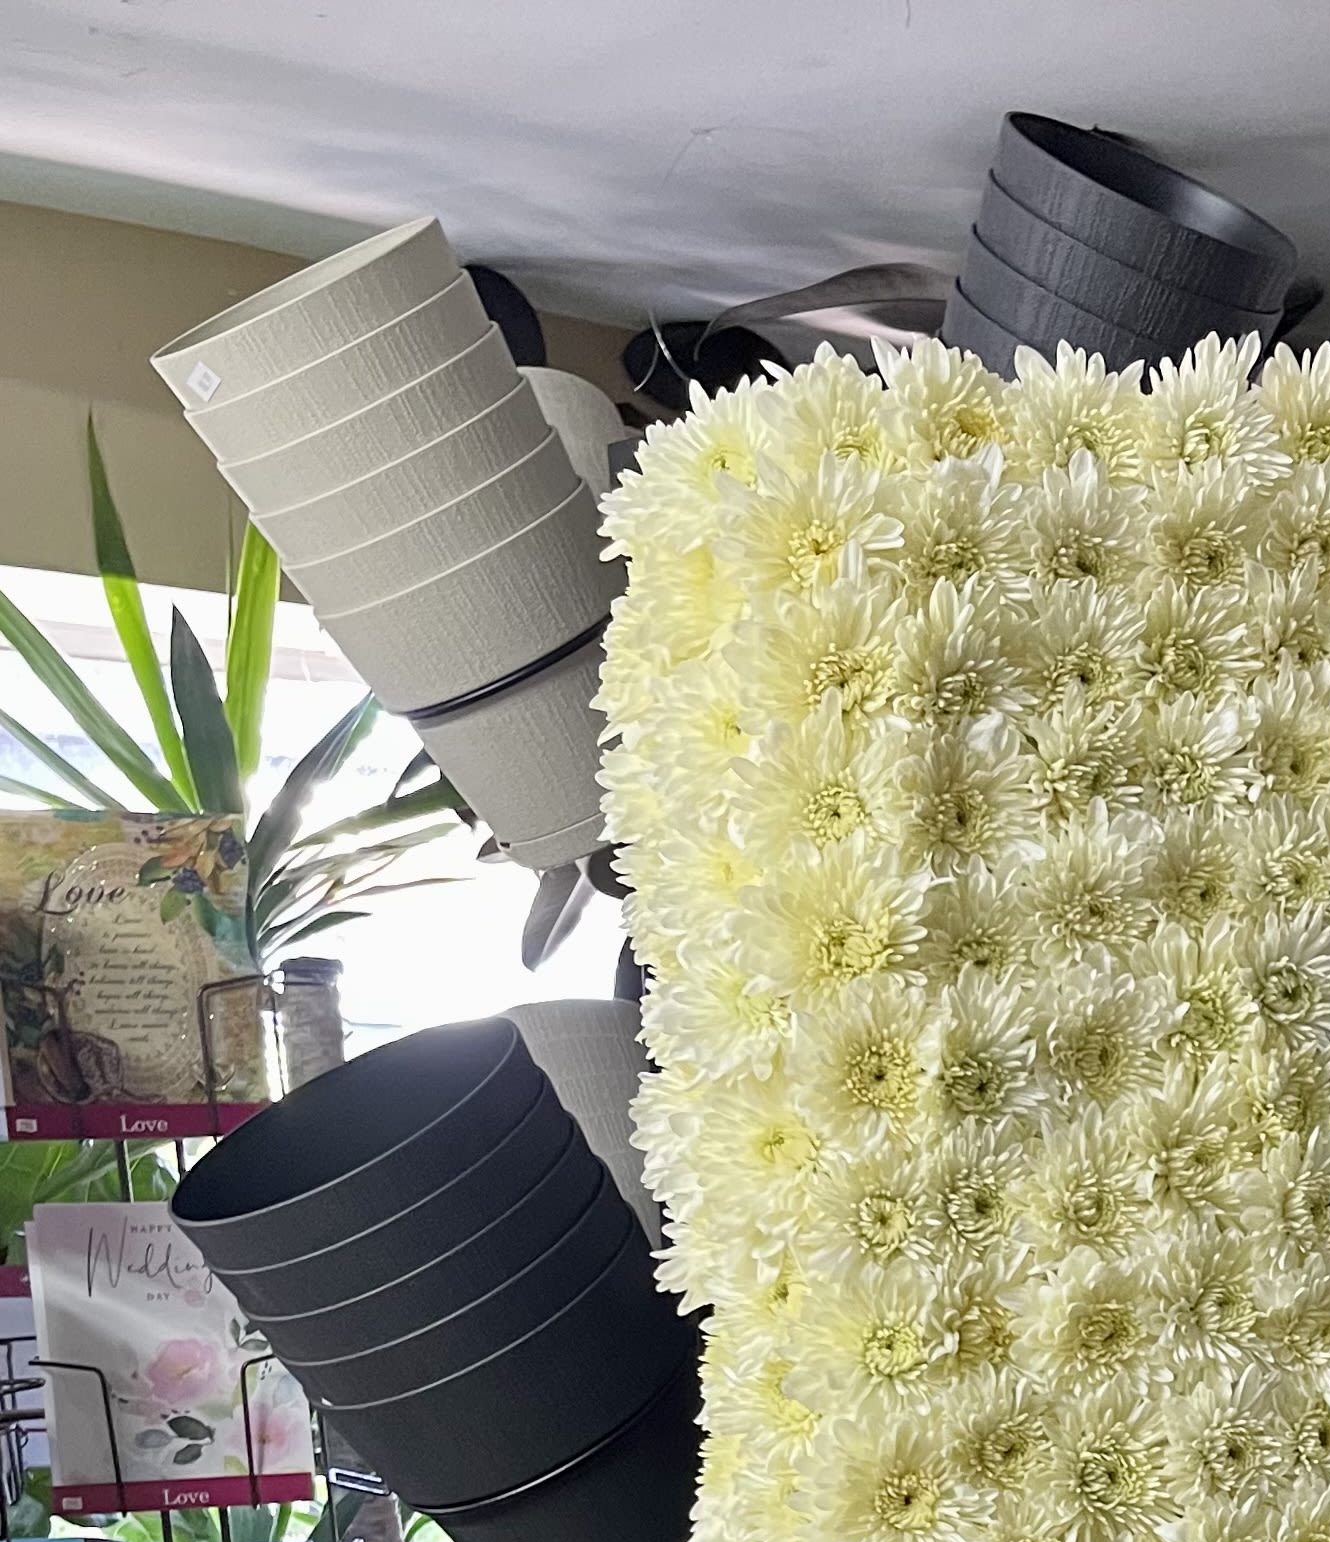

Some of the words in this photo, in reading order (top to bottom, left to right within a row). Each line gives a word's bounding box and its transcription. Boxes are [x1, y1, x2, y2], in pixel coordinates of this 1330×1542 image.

[31, 870, 130, 916] Love
[119, 1114, 169, 1133] Love
[130, 1224, 173, 1234] HAPPY
[87, 1216, 213, 1298] Wedding
[146, 1292, 170, 1302] DAY
[162, 1488, 210, 1506] Love
